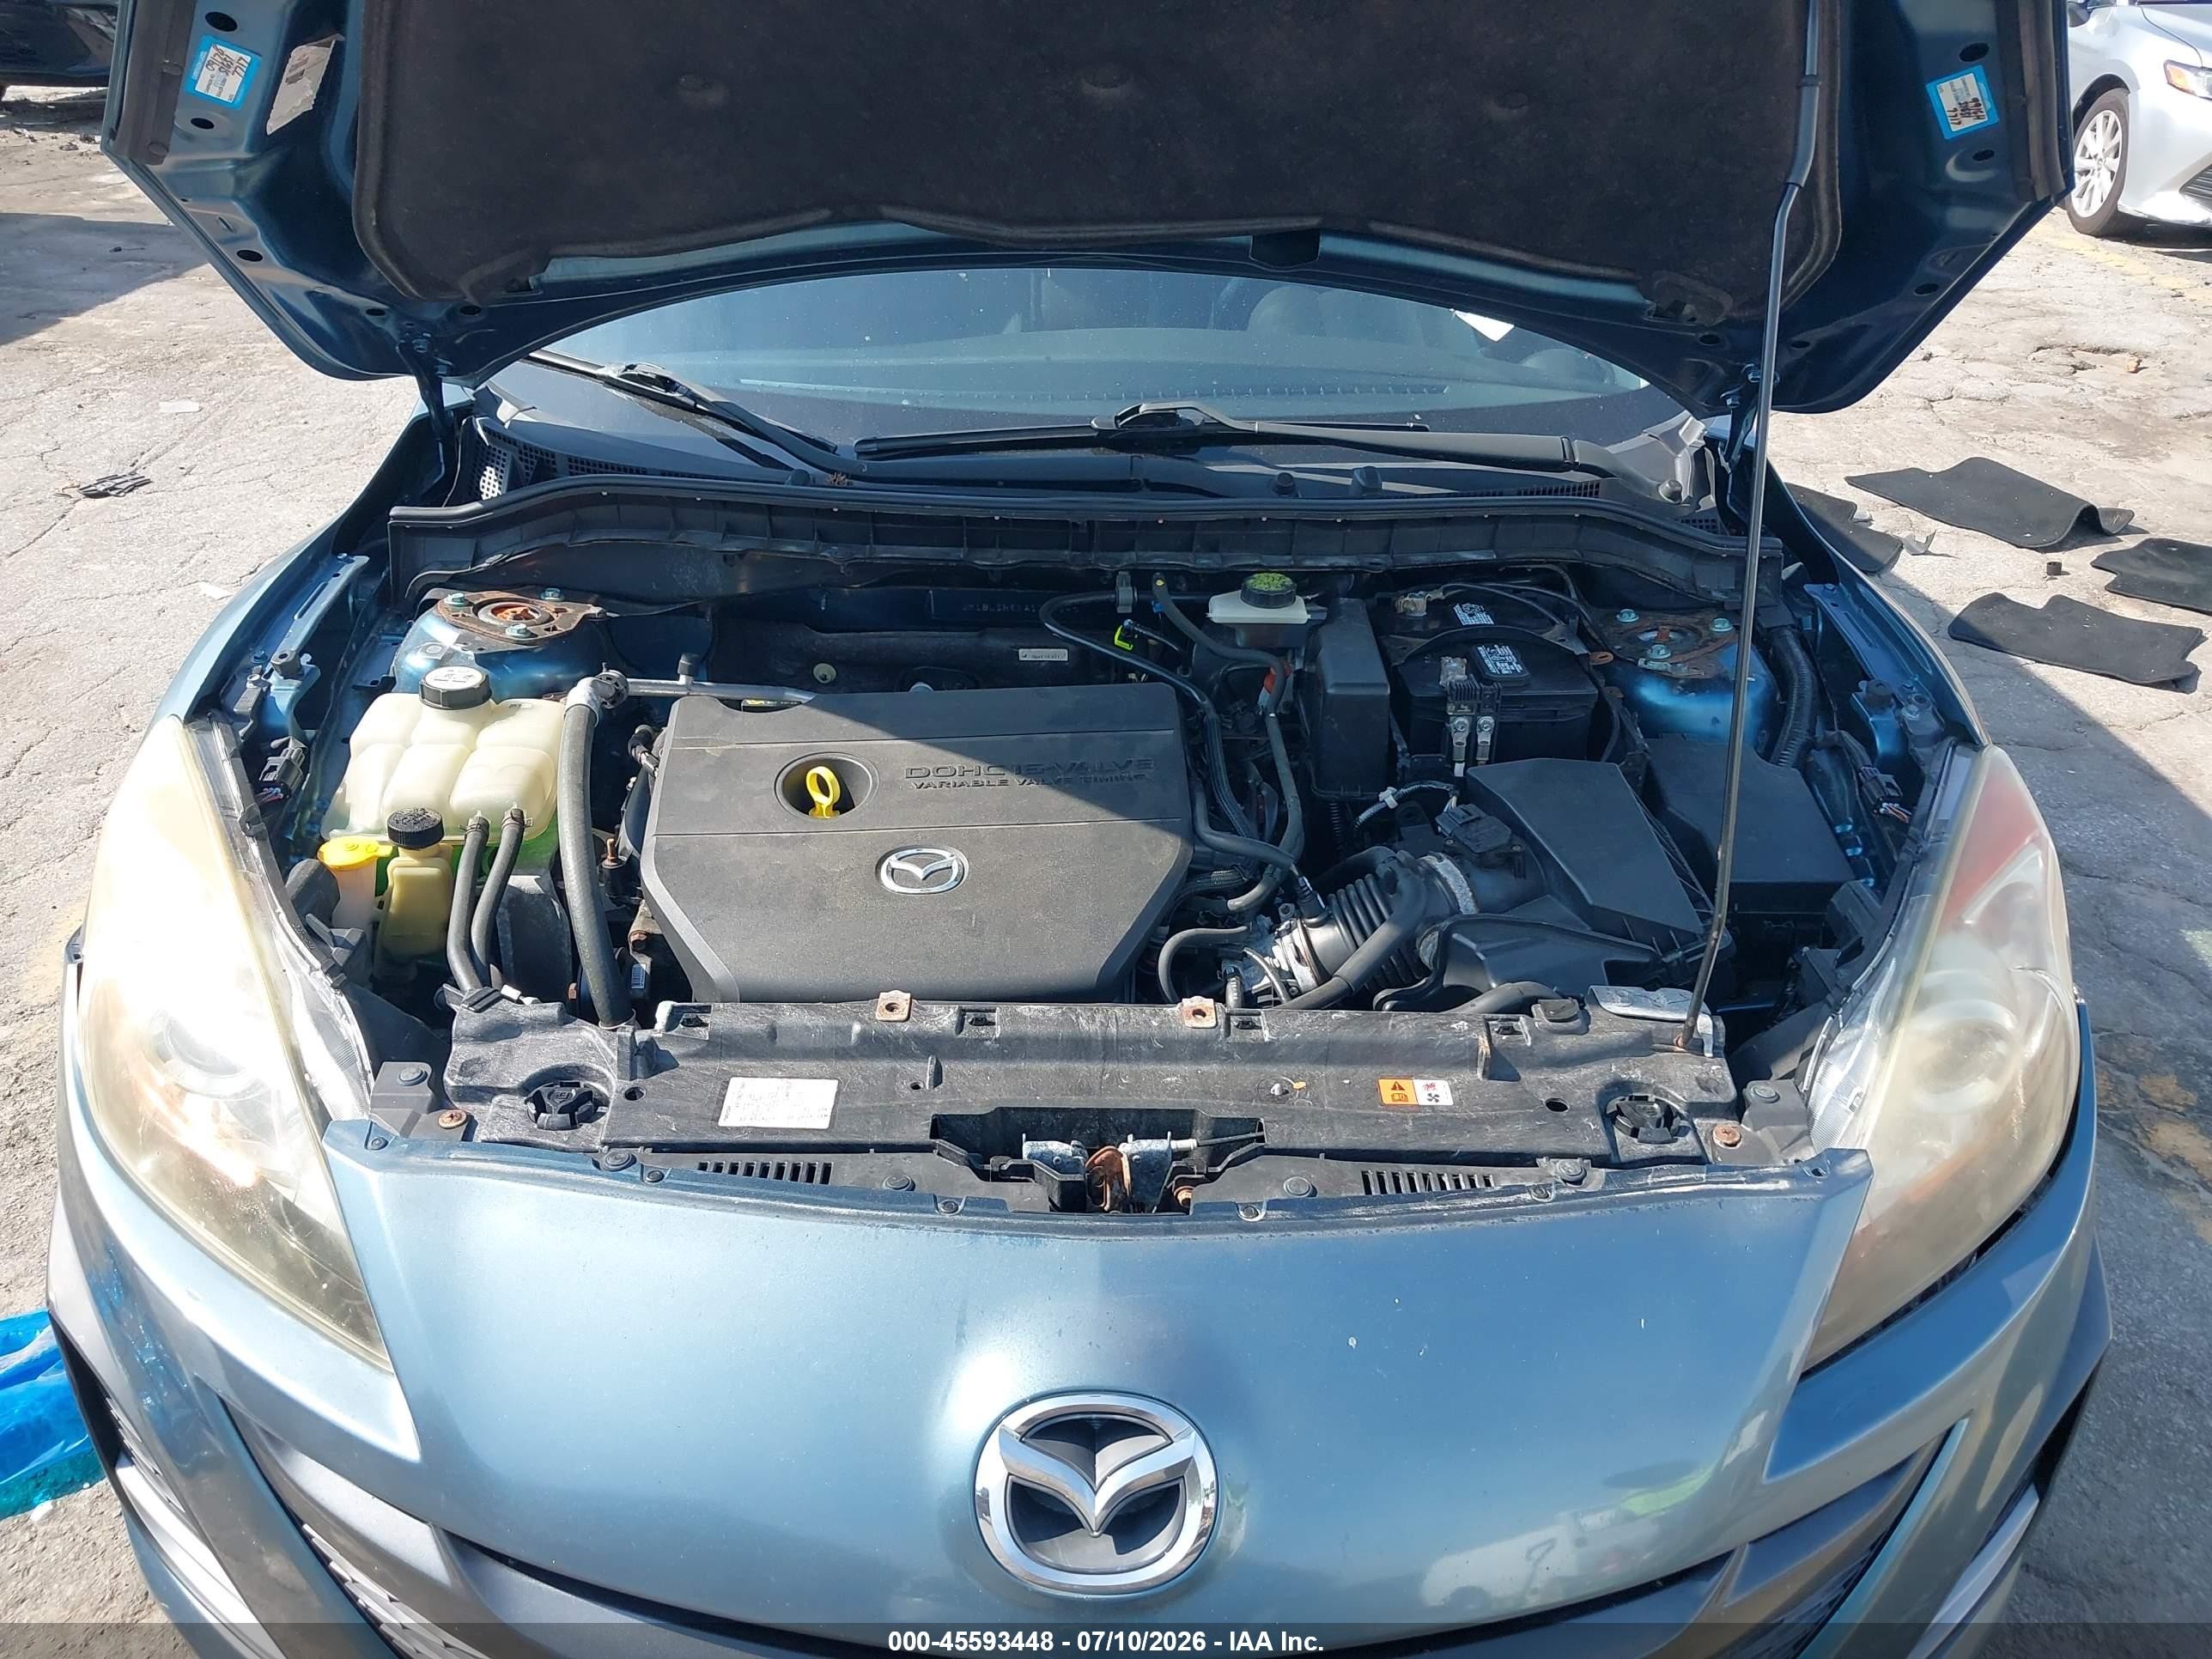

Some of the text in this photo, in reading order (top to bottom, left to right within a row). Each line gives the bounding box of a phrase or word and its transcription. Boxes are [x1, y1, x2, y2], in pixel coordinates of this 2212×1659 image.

[904, 764, 1006, 779] DOHC
[912, 779, 1010, 789] VARIABLE
[1017, 776, 1073, 787] VALVE
